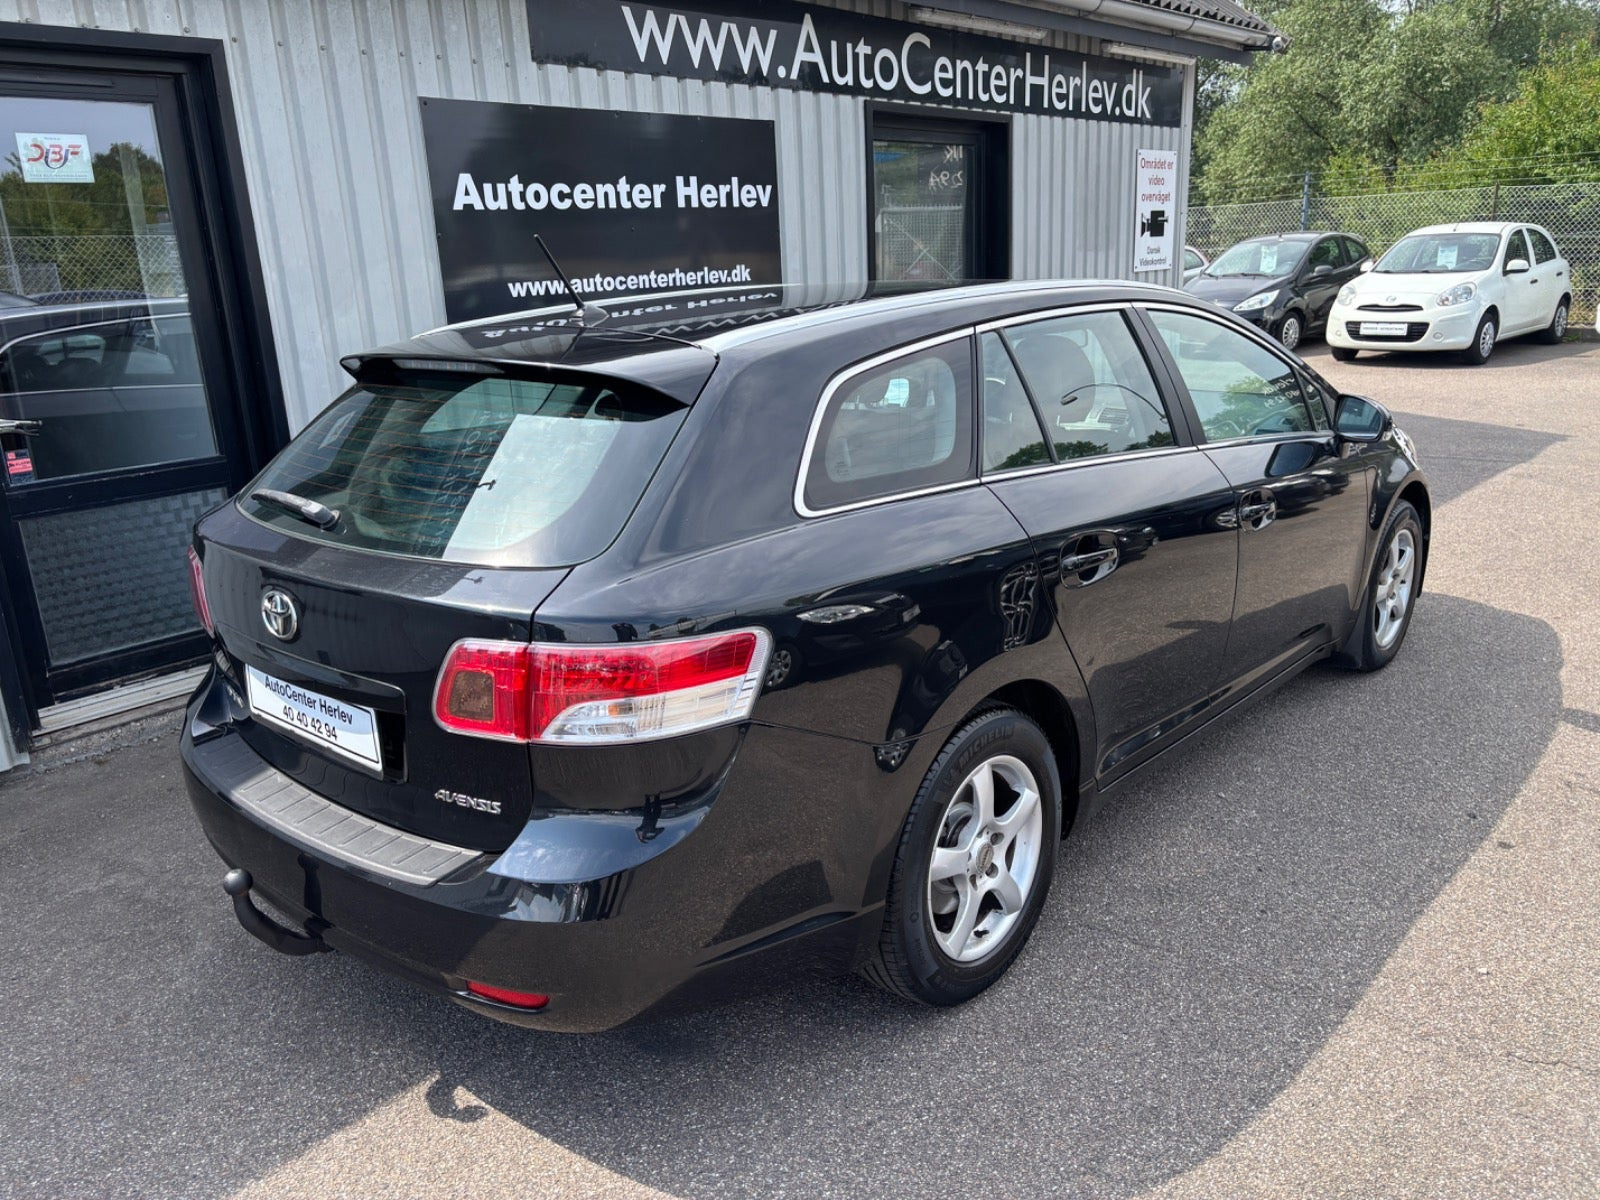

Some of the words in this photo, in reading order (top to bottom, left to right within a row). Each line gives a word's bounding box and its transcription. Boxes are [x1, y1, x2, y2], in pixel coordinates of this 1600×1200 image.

[1140, 157, 1167, 170] Området
[452, 172, 666, 211] Autocenter
[675, 175, 772, 208] Herlev
[1148, 175, 1165, 186] video
[264, 675, 317, 707] AutoCenter
[319, 698, 353, 725] Herlev
[282, 704, 295, 722] 40
[296, 712, 309, 729] 40
[310, 719, 323, 735] 42
[324, 725, 338, 742] 94
[434, 789, 502, 815] AVENSIS
